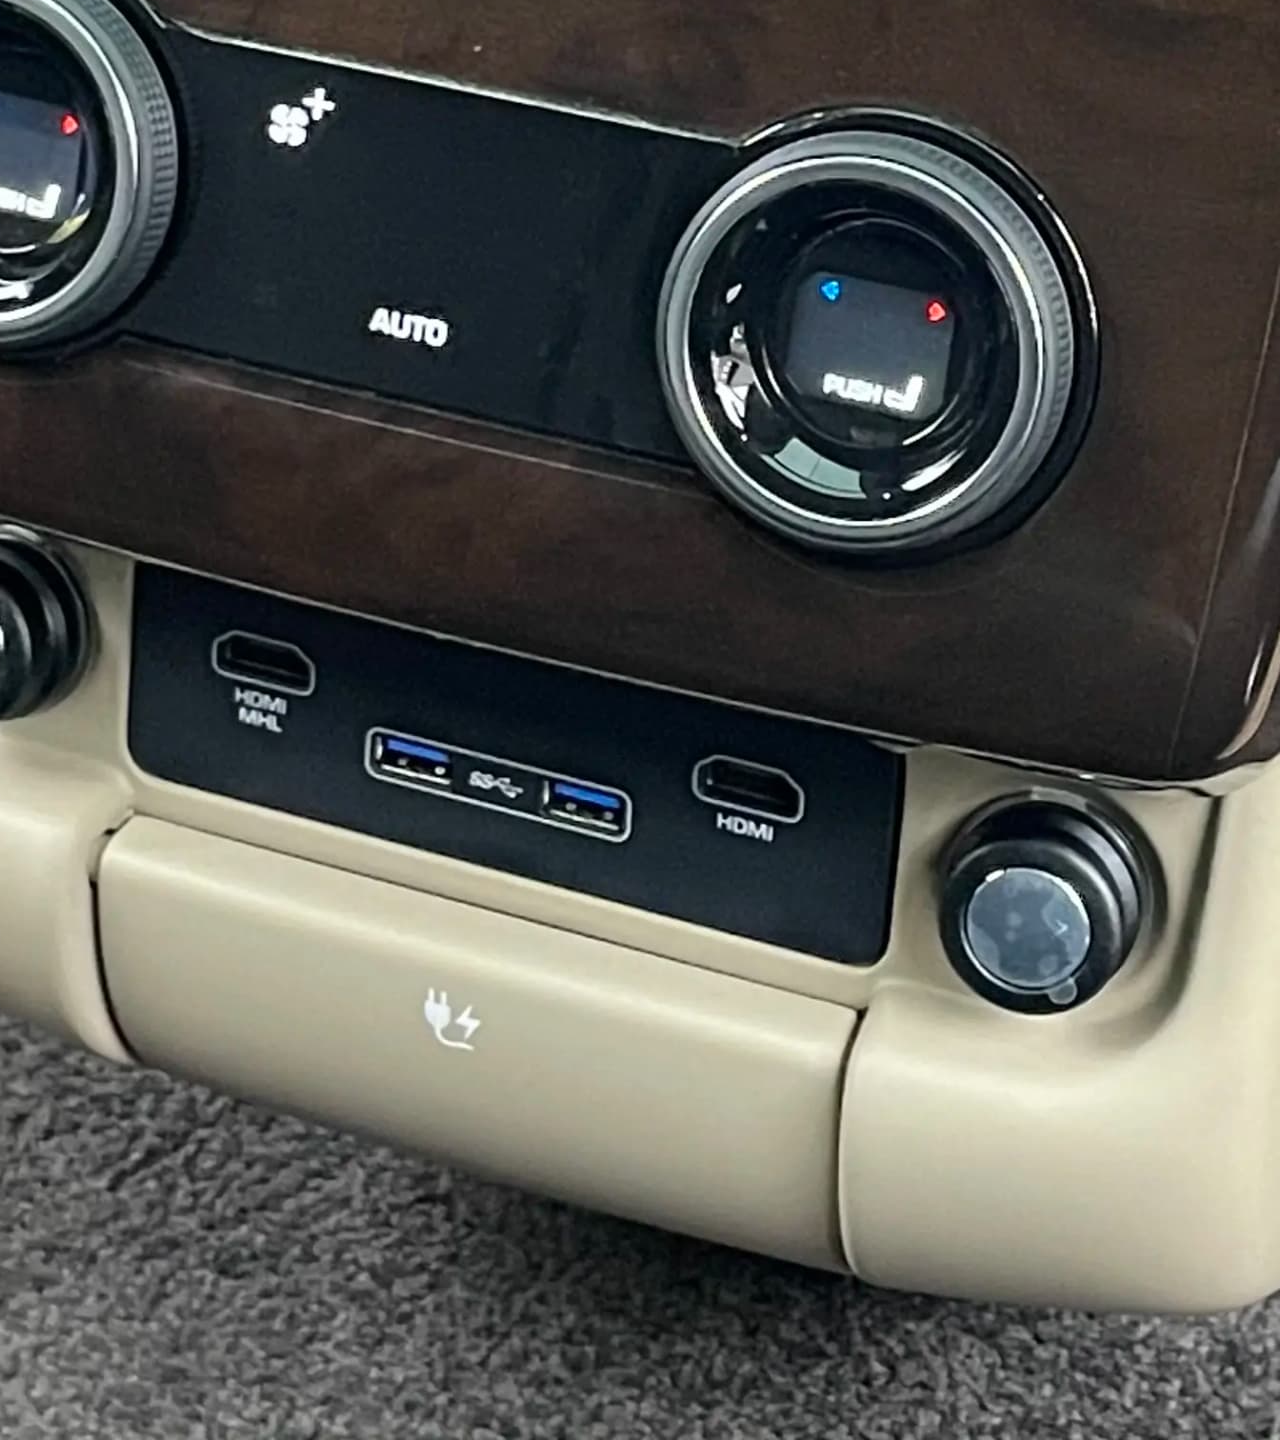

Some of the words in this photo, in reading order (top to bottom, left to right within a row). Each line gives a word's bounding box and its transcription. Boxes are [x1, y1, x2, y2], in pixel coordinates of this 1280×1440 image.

[368, 307, 449, 348] AUTO
[822, 372, 884, 405] PUSH
[234, 686, 287, 715] HDMI
[238, 706, 283, 733] MHL
[716, 812, 774, 842] HDMI
